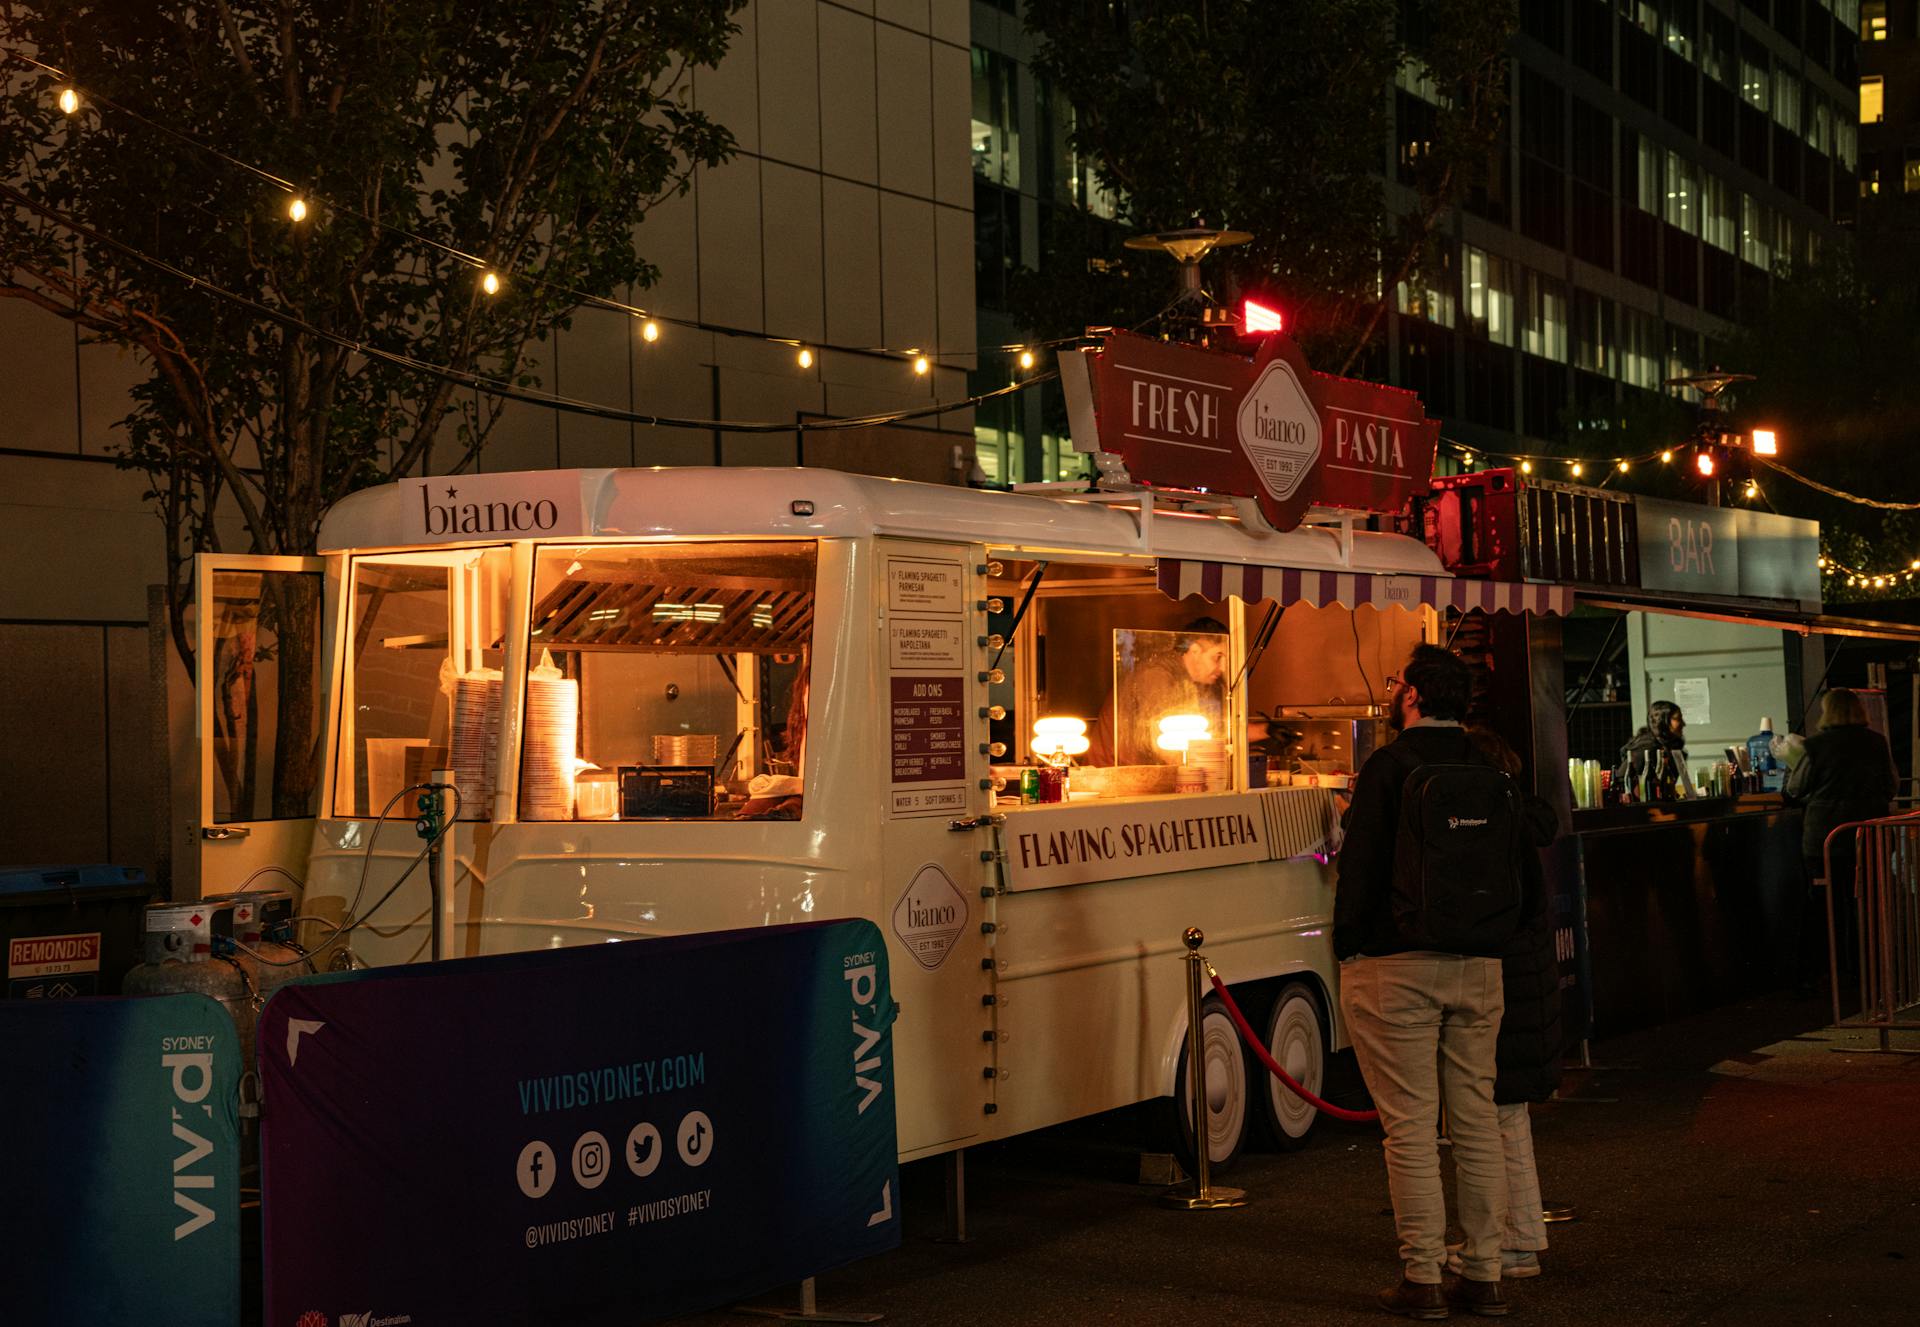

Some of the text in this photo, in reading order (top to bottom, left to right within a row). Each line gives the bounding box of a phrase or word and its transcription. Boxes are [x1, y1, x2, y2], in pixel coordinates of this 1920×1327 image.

[1132, 380, 1219, 440] FRESH
[1255, 399, 1305, 445] bianco
[1336, 418, 1404, 468] PASTA
[1266, 458, 1278, 472] EST
[419, 484, 558, 535] bianco
[1669, 517, 1716, 575] BAR
[898, 571, 920, 581] FLAMING
[920, 572, 947, 583] SPAGHETTI
[899, 582, 925, 592] PARMESAN
[1384, 577, 1409, 601] bianco
[899, 628, 921, 638] FLAMING
[921, 629, 947, 639] SPAGHETTI
[900, 640, 931, 650] NAPOLETANA
[913, 683, 942, 697] ADD ONS
[896, 797, 912, 807] WATER
[925, 795, 938, 806] SOFT
[938, 793, 956, 804] DRINKS
[1019, 813, 1259, 869] FLAMING SPAGHETTERIA
[908, 898, 955, 929] bianco
[919, 941, 931, 951] EST
[844, 951, 877, 968] SYDNEY
[162, 1036, 215, 1051] SYDNEY
[518, 1052, 705, 1115] VIVIDSYDNEY.COM
[526, 1189, 711, 1249] @VIVIDSYDNEY #VIVIDSYDNEY
